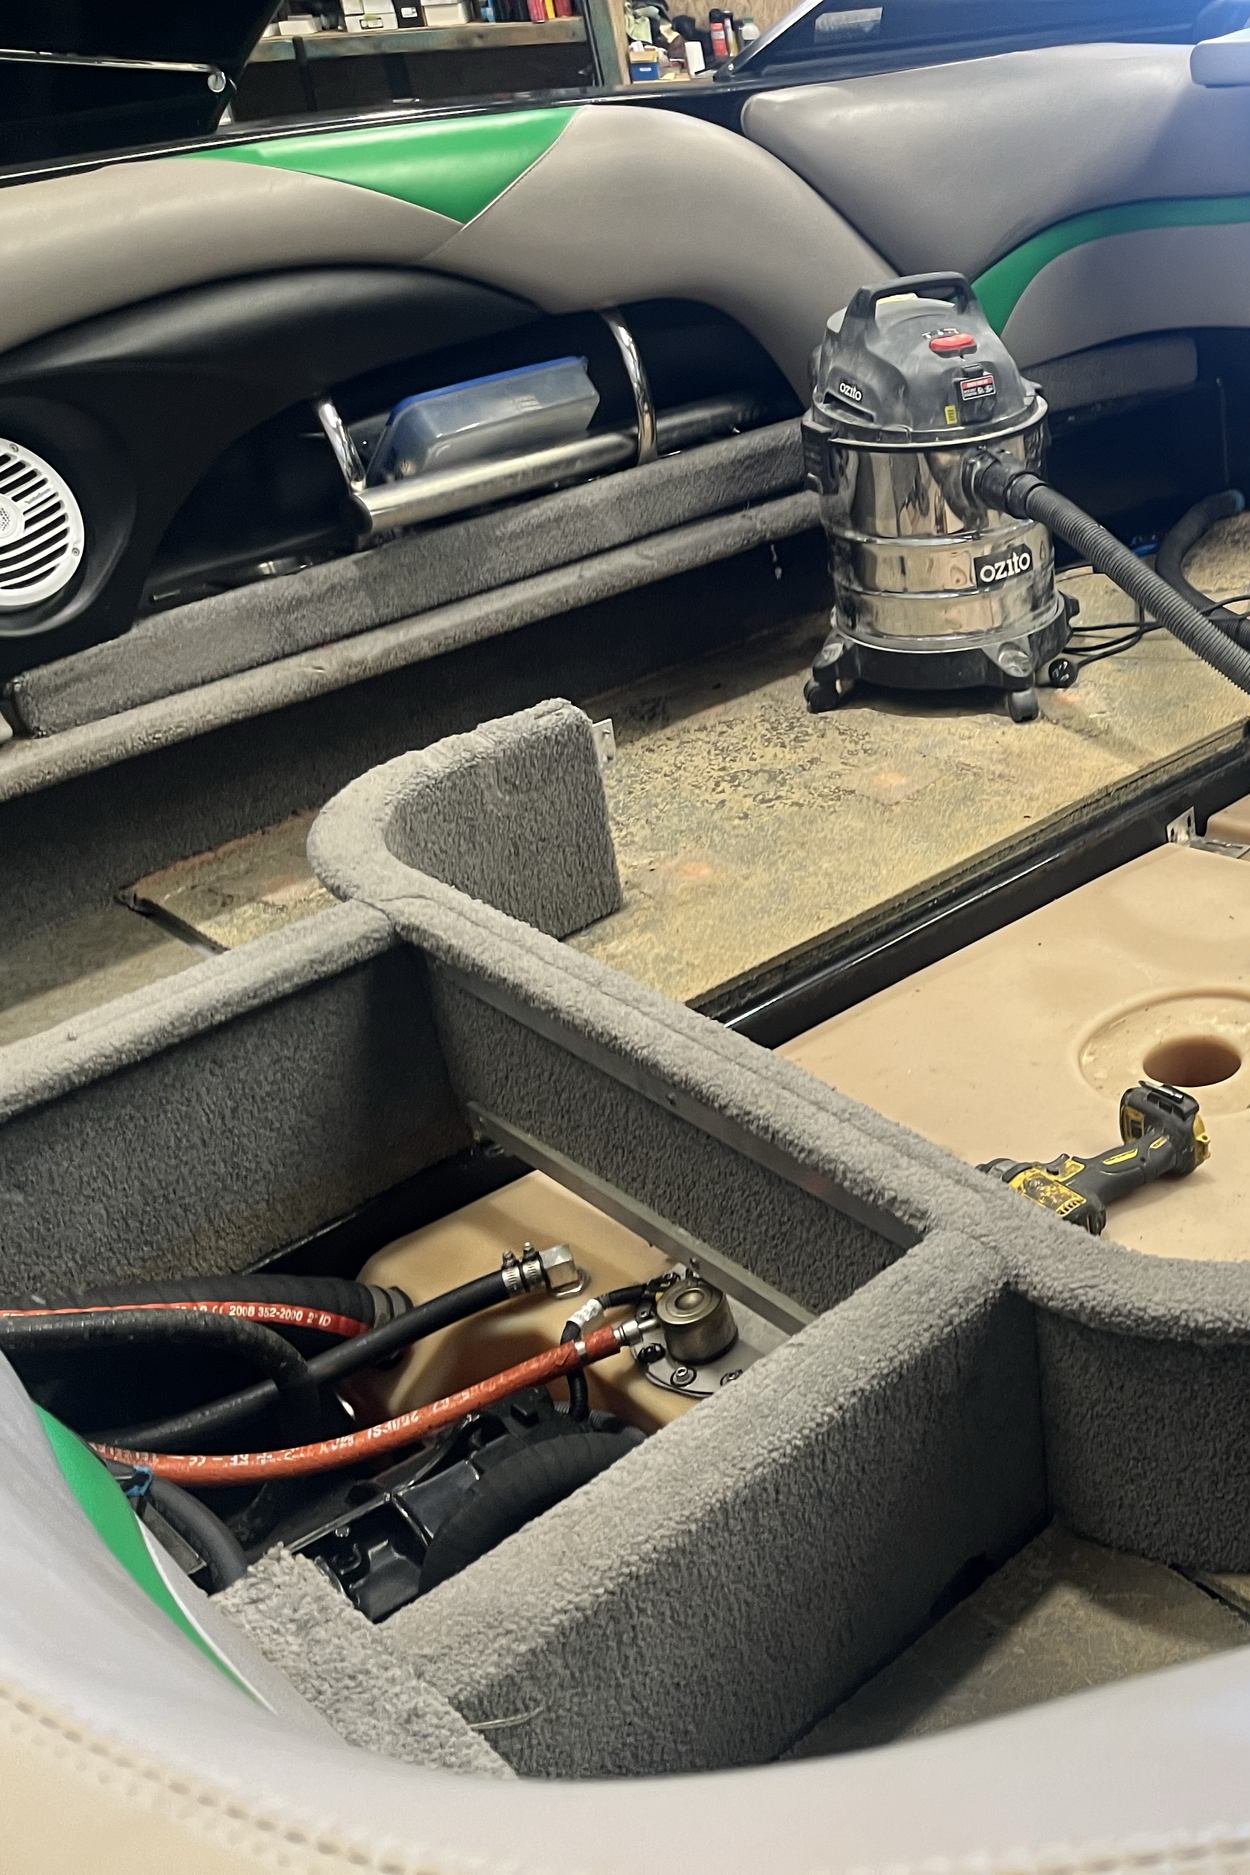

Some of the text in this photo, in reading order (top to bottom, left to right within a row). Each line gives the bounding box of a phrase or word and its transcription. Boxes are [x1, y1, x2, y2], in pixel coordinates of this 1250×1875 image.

[840, 382, 862, 401] ozito
[980, 551, 1030, 582] ozito
[319, 1314, 331, 1327] ID
